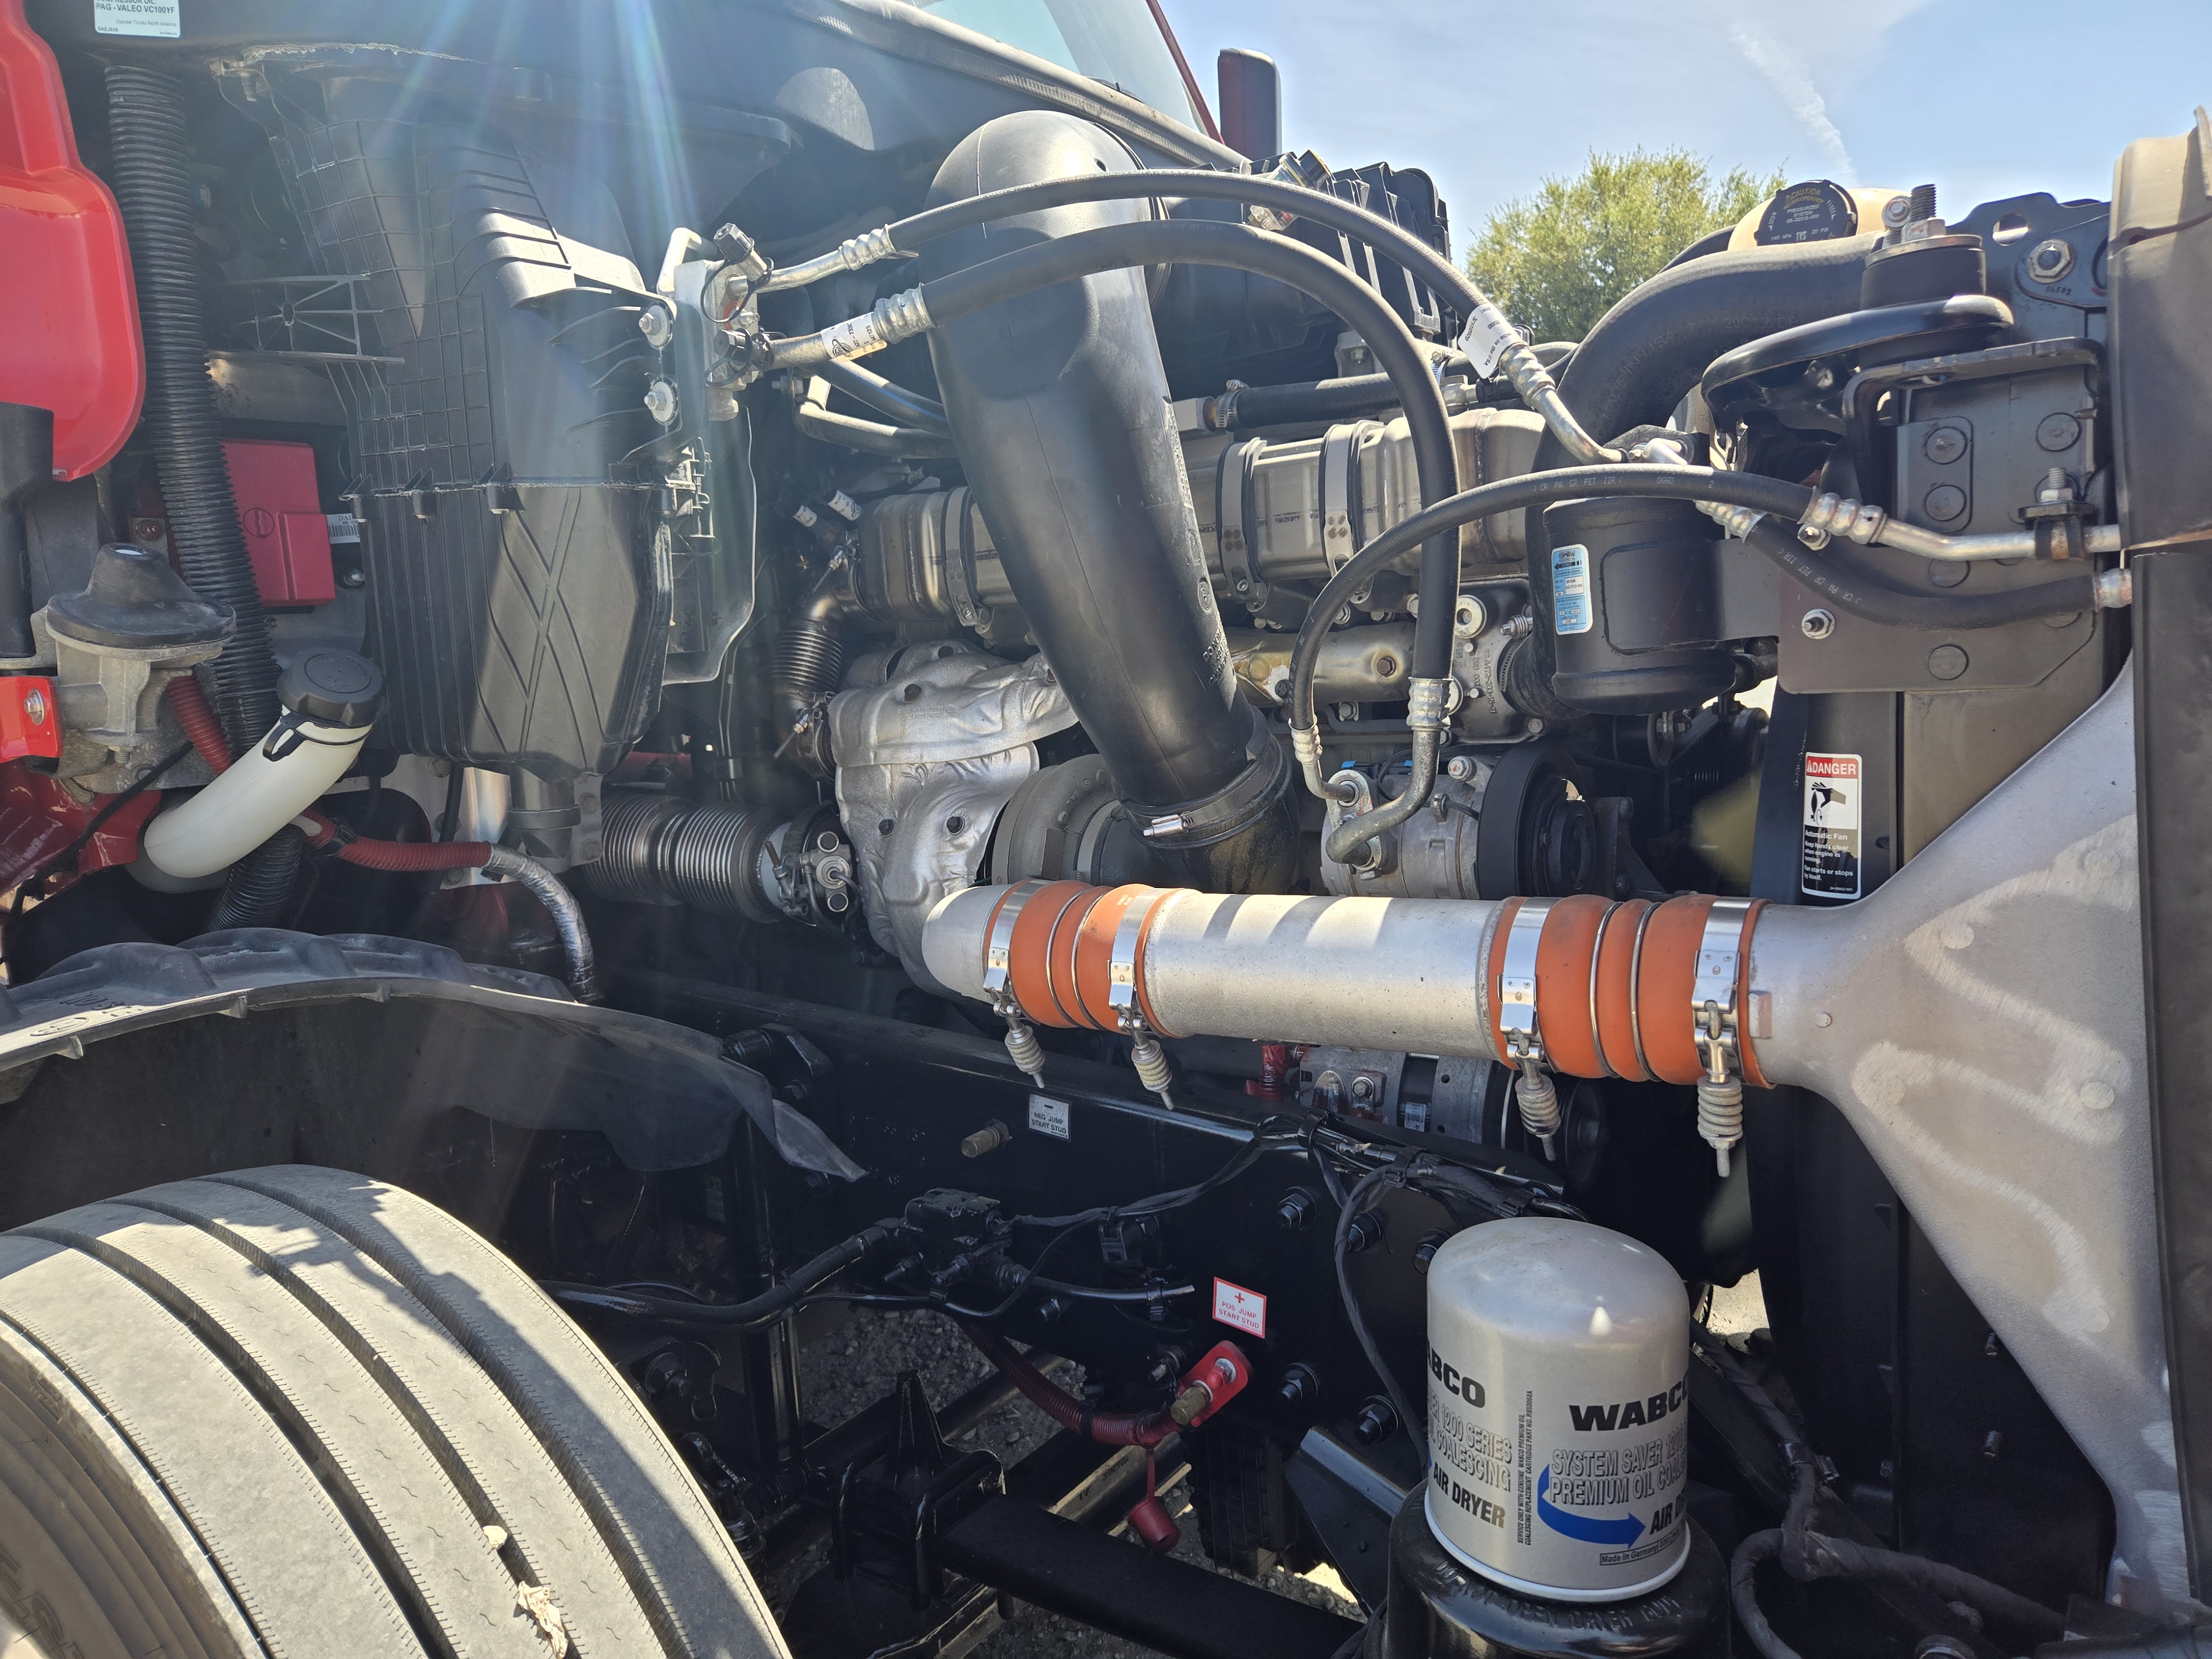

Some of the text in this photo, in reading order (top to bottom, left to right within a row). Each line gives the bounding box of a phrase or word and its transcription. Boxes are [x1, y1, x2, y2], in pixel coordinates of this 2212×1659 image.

[117, 4, 142, 12] VALEO
[143, 6, 175, 14] VC100YF
[1791, 188, 1822, 198] CAUTION
[1786, 204, 1820, 213] PRESSURIZED
[1483, 354, 1493, 367] USA
[1813, 762, 1856, 775] DANGER
[1805, 830, 1848, 841] Automatic Fan
[1814, 842, 1832, 851] hands
[1815, 849, 1834, 858] engine
[1811, 866, 1826, 875] starts
[1034, 1112, 1064, 1125] NEG JUMP
[1031, 1119, 1066, 1134] START STUD
[1222, 1301, 1257, 1319] POS JUMP
[1218, 1308, 1240, 1321] START
[1241, 1317, 1259, 1328] STUD
[1441, 1403, 1463, 1442] 1200
[1466, 1422, 1512, 1464] SERIES
[1437, 1425, 1511, 1493] COALESCING
[1551, 1448, 1619, 1477] SYSTEM
[1621, 1438, 1663, 1474] SAVER
[1433, 1461, 1506, 1529] AIR DRYER
[1549, 1476, 1629, 1506] PREMIUM
[1632, 1470, 1655, 1499] OIL
[1648, 1502, 1673, 1536] AIR
[1601, 1544, 1658, 1563] Made in Germany
